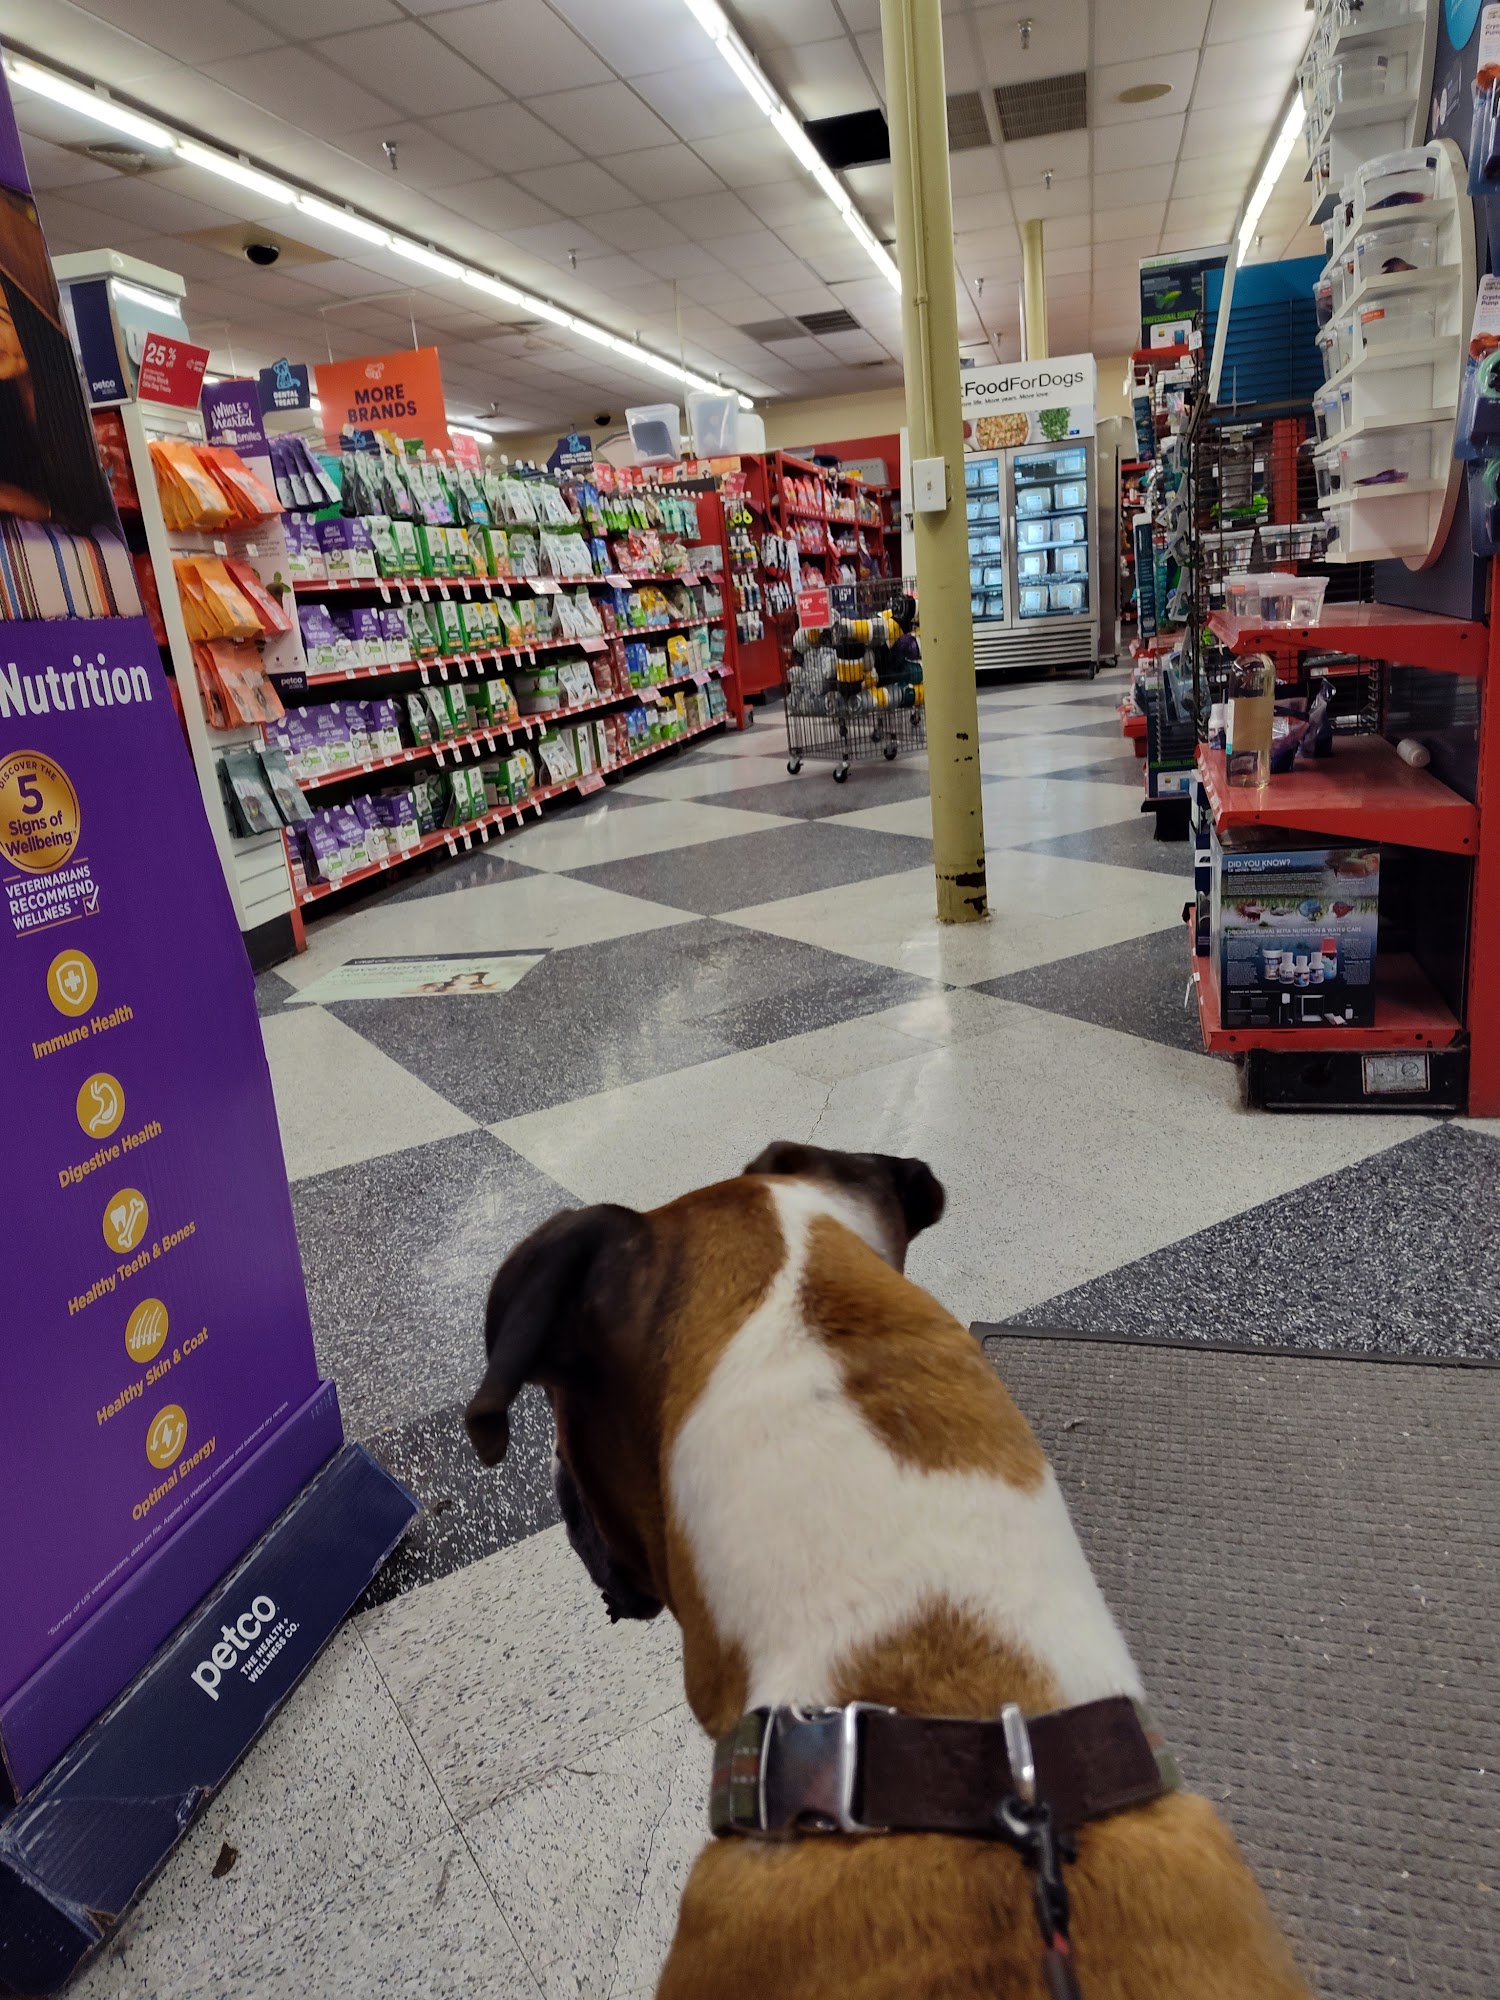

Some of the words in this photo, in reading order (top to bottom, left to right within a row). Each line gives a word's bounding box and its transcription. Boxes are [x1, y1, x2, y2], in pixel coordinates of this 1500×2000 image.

[92, 379, 116, 392] petco
[273, 390, 299, 399] DENTAL
[354, 383, 405, 405] MORE
[961, 371, 1084, 398] FoodForDogs
[213, 401, 243, 420] WHOLE
[274, 397, 299, 407] TREATS
[347, 400, 418, 424] BRANDS
[210, 409, 255, 430] hearted
[0, 653, 153, 718] Nutrition
[280, 677, 303, 687] petco
[0, 761, 37, 790] DISCOVER
[41, 764, 57, 782] THE
[17, 774, 44, 815] 5
[8, 817, 47, 836] Signs
[50, 810, 63, 827] of
[1228, 860, 1242, 868] DID
[1243, 859, 1260, 868] YOU
[1261, 858, 1291, 867] KNOW?
[5, 865, 91, 898] VETERINARIANS
[9, 880, 95, 915] RECOMMEND
[12, 902, 72, 931] WELLNESS
[31, 1025, 89, 1060] Immune
[90, 1004, 134, 1035] Health
[58, 1143, 120, 1188] Digestive
[121, 1120, 162, 1153] Health
[67, 1272, 117, 1316] Healthy
[117, 1250, 151, 1281] Teeth
[152, 1242, 161, 1258] &
[162, 1221, 196, 1252] Bones
[96, 1379, 144, 1426] Healthy
[145, 1358, 171, 1386] Skin
[173, 1348, 181, 1363] &
[182, 1327, 209, 1356] Coat
[132, 1469, 178, 1521] Optimal
[178, 1436, 217, 1479] Energy
[73, 1601, 81, 1613] of
[81, 1592, 91, 1605] US
[91, 1556, 131, 1595] veterinarians,
[130, 1541, 144, 1557] data
[144, 1534, 152, 1544] on
[152, 1524, 163, 1536] file.
[163, 1503, 184, 1525] Applies
[183, 1497, 190, 1505] to
[189, 1476, 212, 1499] Wellness
[211, 1453, 235, 1479] complete
[234, 1442, 244, 1456] and
[243, 1423, 265, 1447] balanced
[264, 1415, 273, 1427] dry
[190, 1595, 276, 1702] petco
[240, 1655, 259, 1676] THE
[255, 1621, 285, 1658] HEALTH
[247, 1636, 287, 1684] WELLNESS
[284, 1622, 300, 1638] CO.
